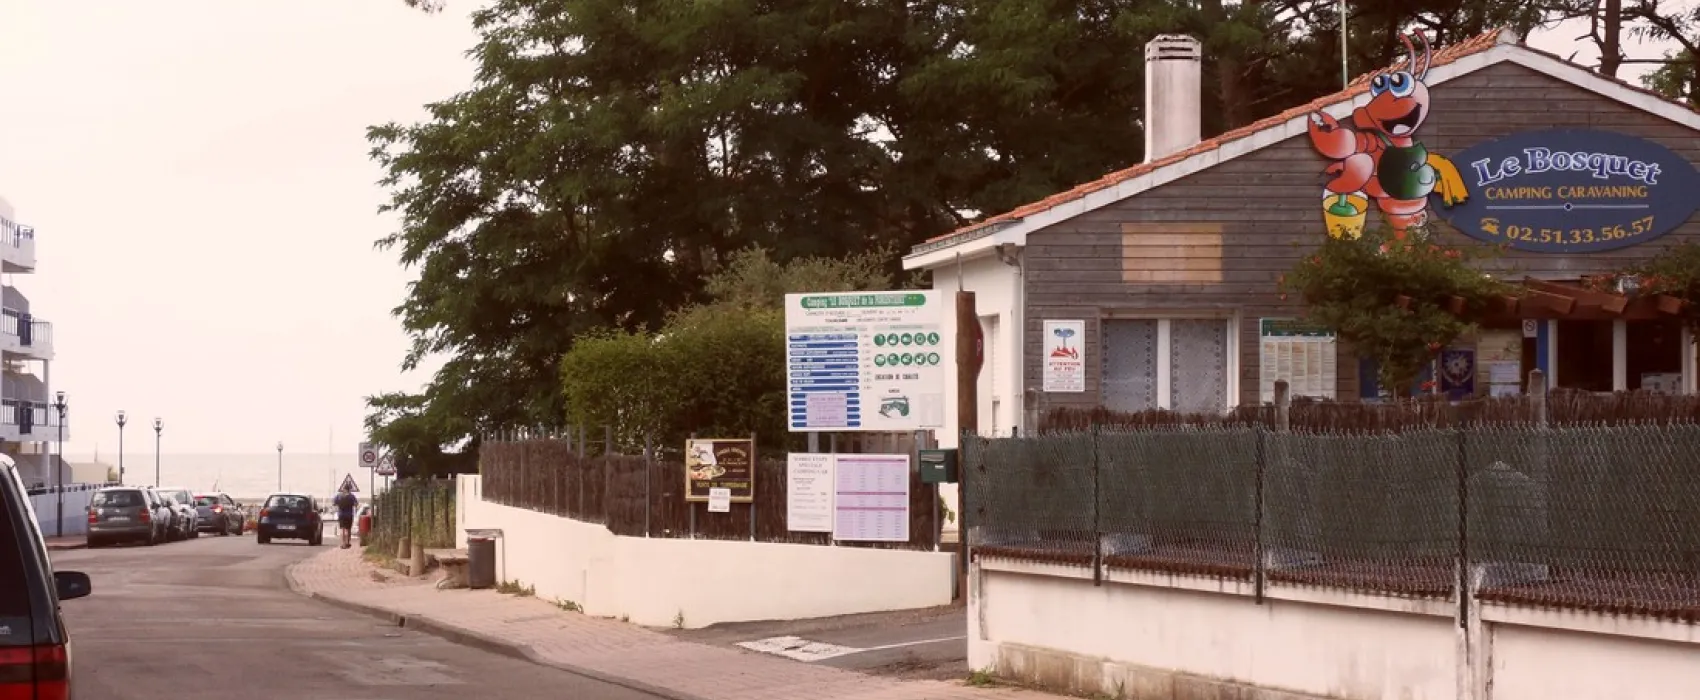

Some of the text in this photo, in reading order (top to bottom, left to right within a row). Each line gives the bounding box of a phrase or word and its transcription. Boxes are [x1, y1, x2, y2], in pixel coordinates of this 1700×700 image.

[1471, 147, 1661, 187] Le Bosquet
[1485, 185, 1649, 200] CAMPING CARAVANING
[1506, 215, 1655, 245] 02.51.33.56.57
